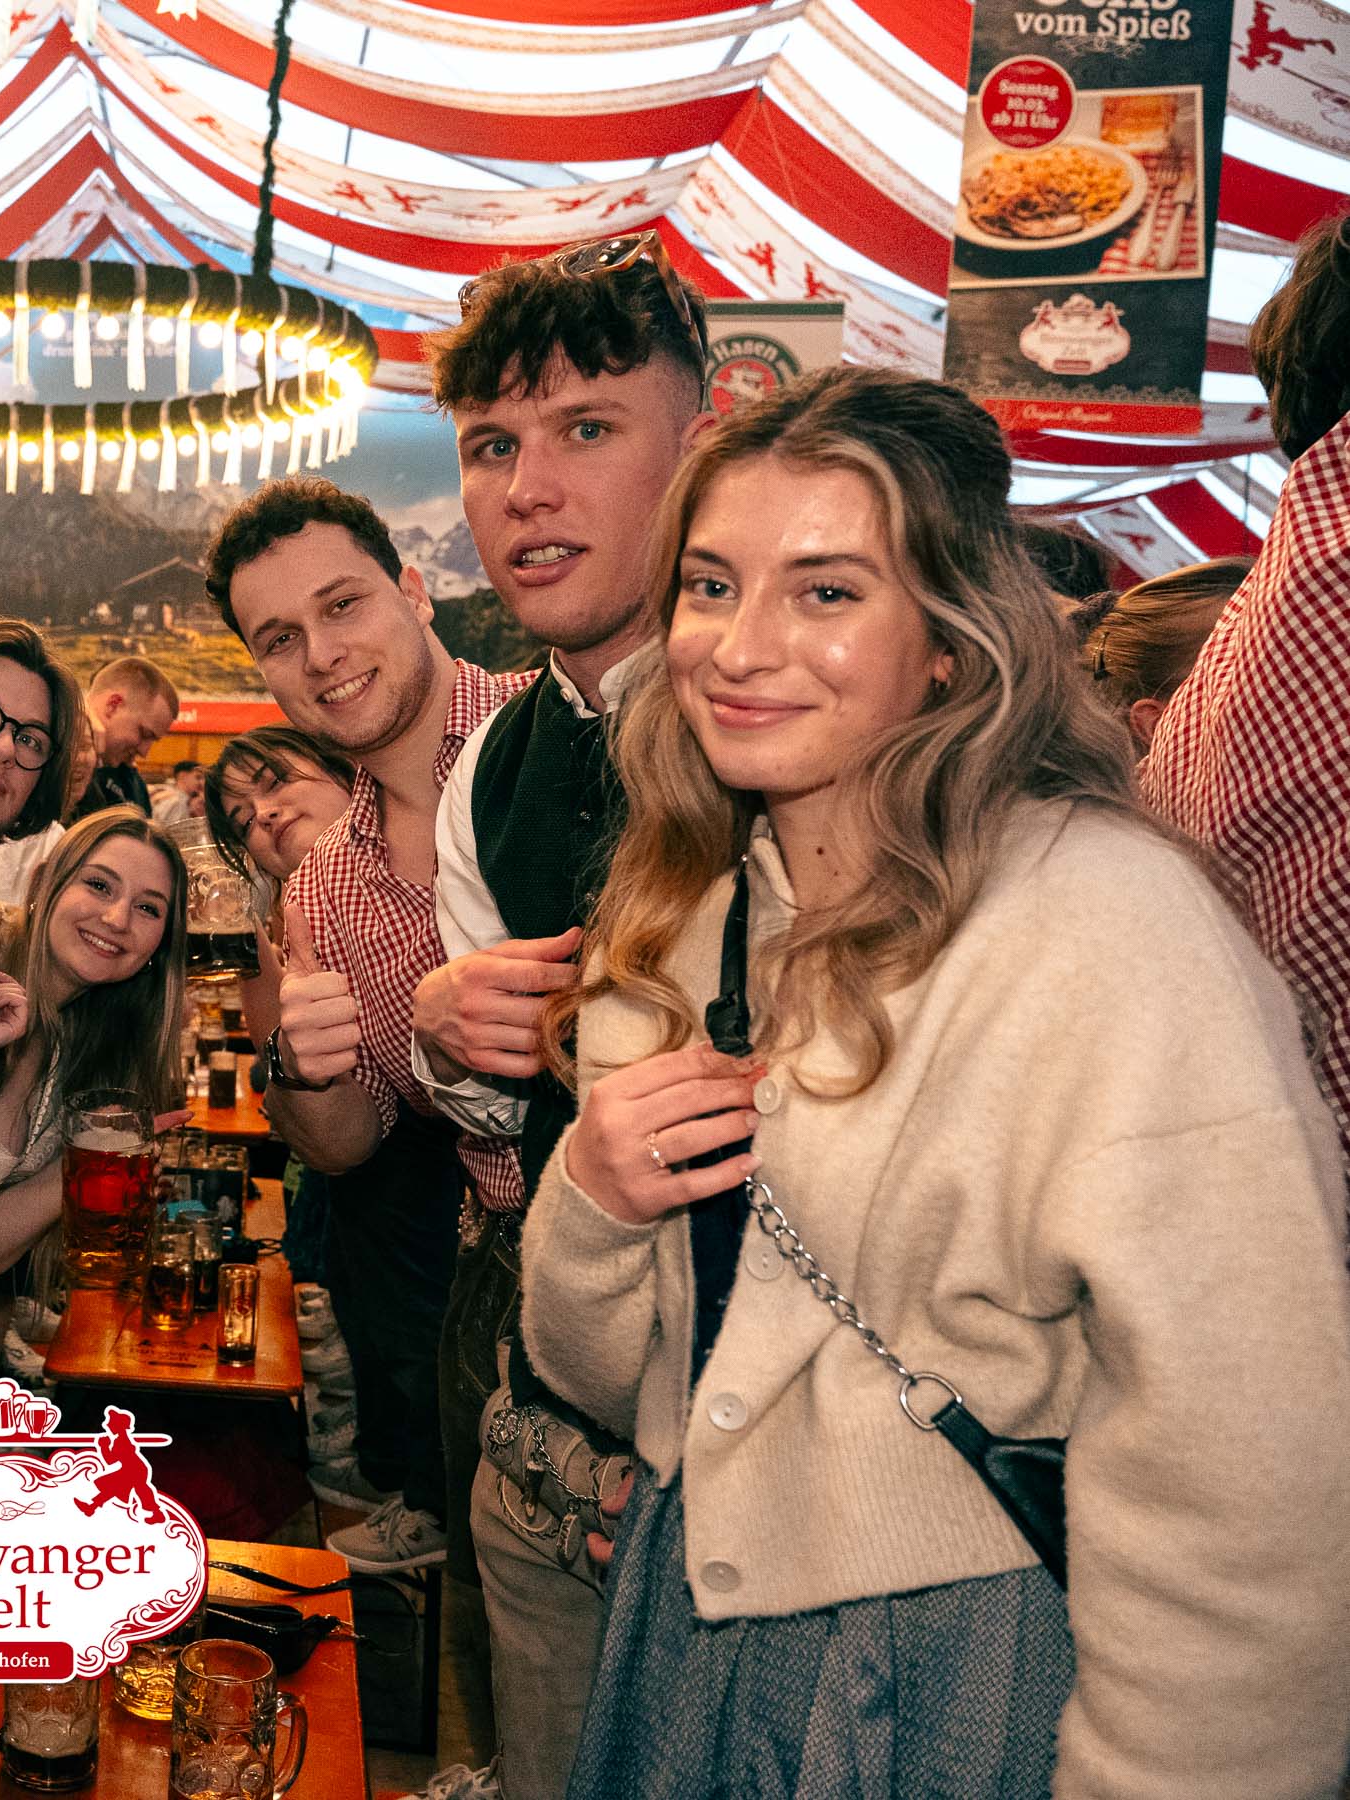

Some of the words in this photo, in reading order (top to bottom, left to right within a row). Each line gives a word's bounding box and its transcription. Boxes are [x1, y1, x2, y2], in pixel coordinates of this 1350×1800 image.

[1014, 12, 1088, 36] vom
[1096, 8, 1192, 46] Spieß
[998, 79, 1059, 101] Sonntag
[990, 110, 1012, 127] ab
[1029, 112, 1060, 129] Uhr
